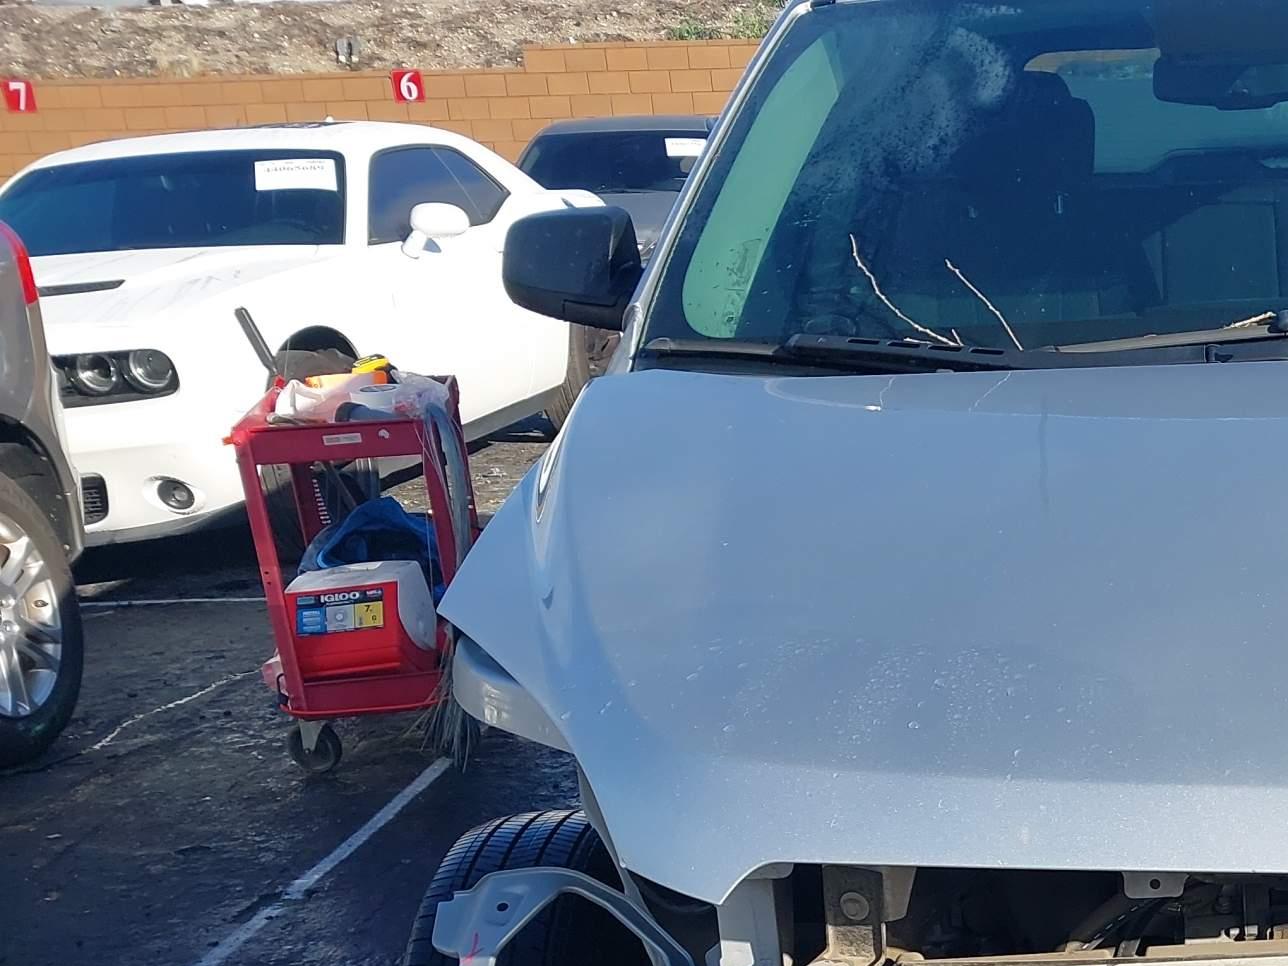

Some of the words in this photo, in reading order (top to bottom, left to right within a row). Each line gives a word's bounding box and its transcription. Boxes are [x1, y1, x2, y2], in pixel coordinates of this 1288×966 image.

[8, 81, 26, 111] 7
[400, 71, 418, 100] 6
[320, 591, 360, 603] IGLOO
